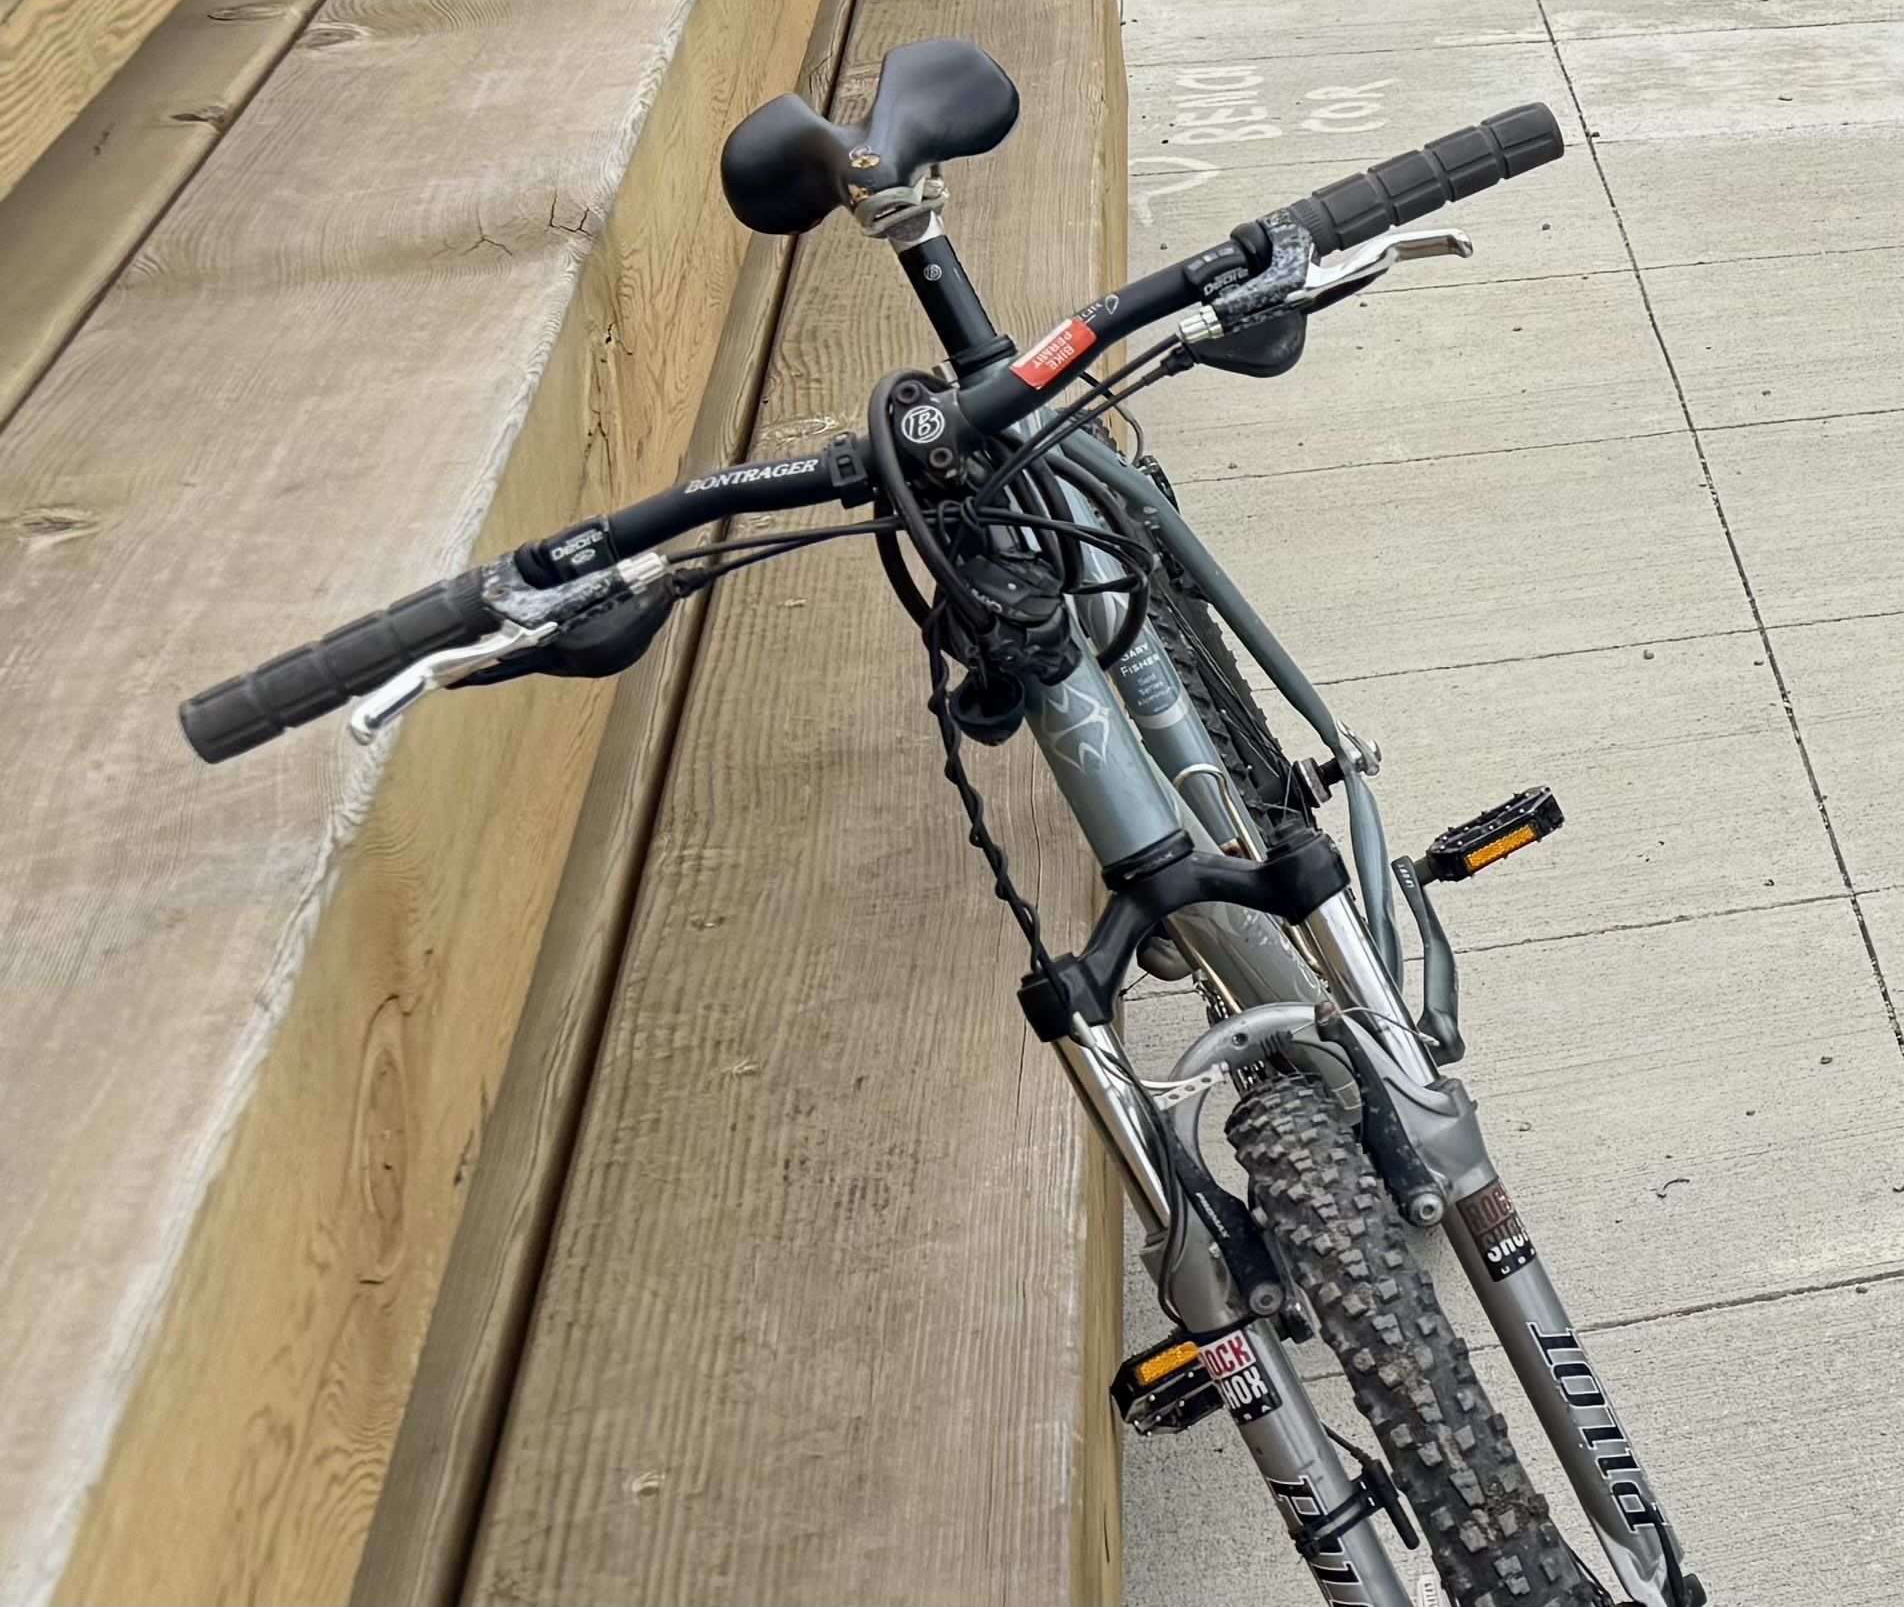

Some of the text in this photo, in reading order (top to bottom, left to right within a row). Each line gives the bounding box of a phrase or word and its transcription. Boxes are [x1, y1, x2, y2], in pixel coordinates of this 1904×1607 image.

[1032, 331, 1073, 368] PERMIT
[1046, 343, 1076, 371] BIKE
[684, 459, 819, 494] BONTRAGER
[1465, 1185, 1514, 1233] ROC
[1483, 1216, 1529, 1263] SHO
[1203, 1335, 1252, 1377] OCK
[1219, 1364, 1269, 1410] HOX
[1526, 1320, 1668, 1534] PILOT
